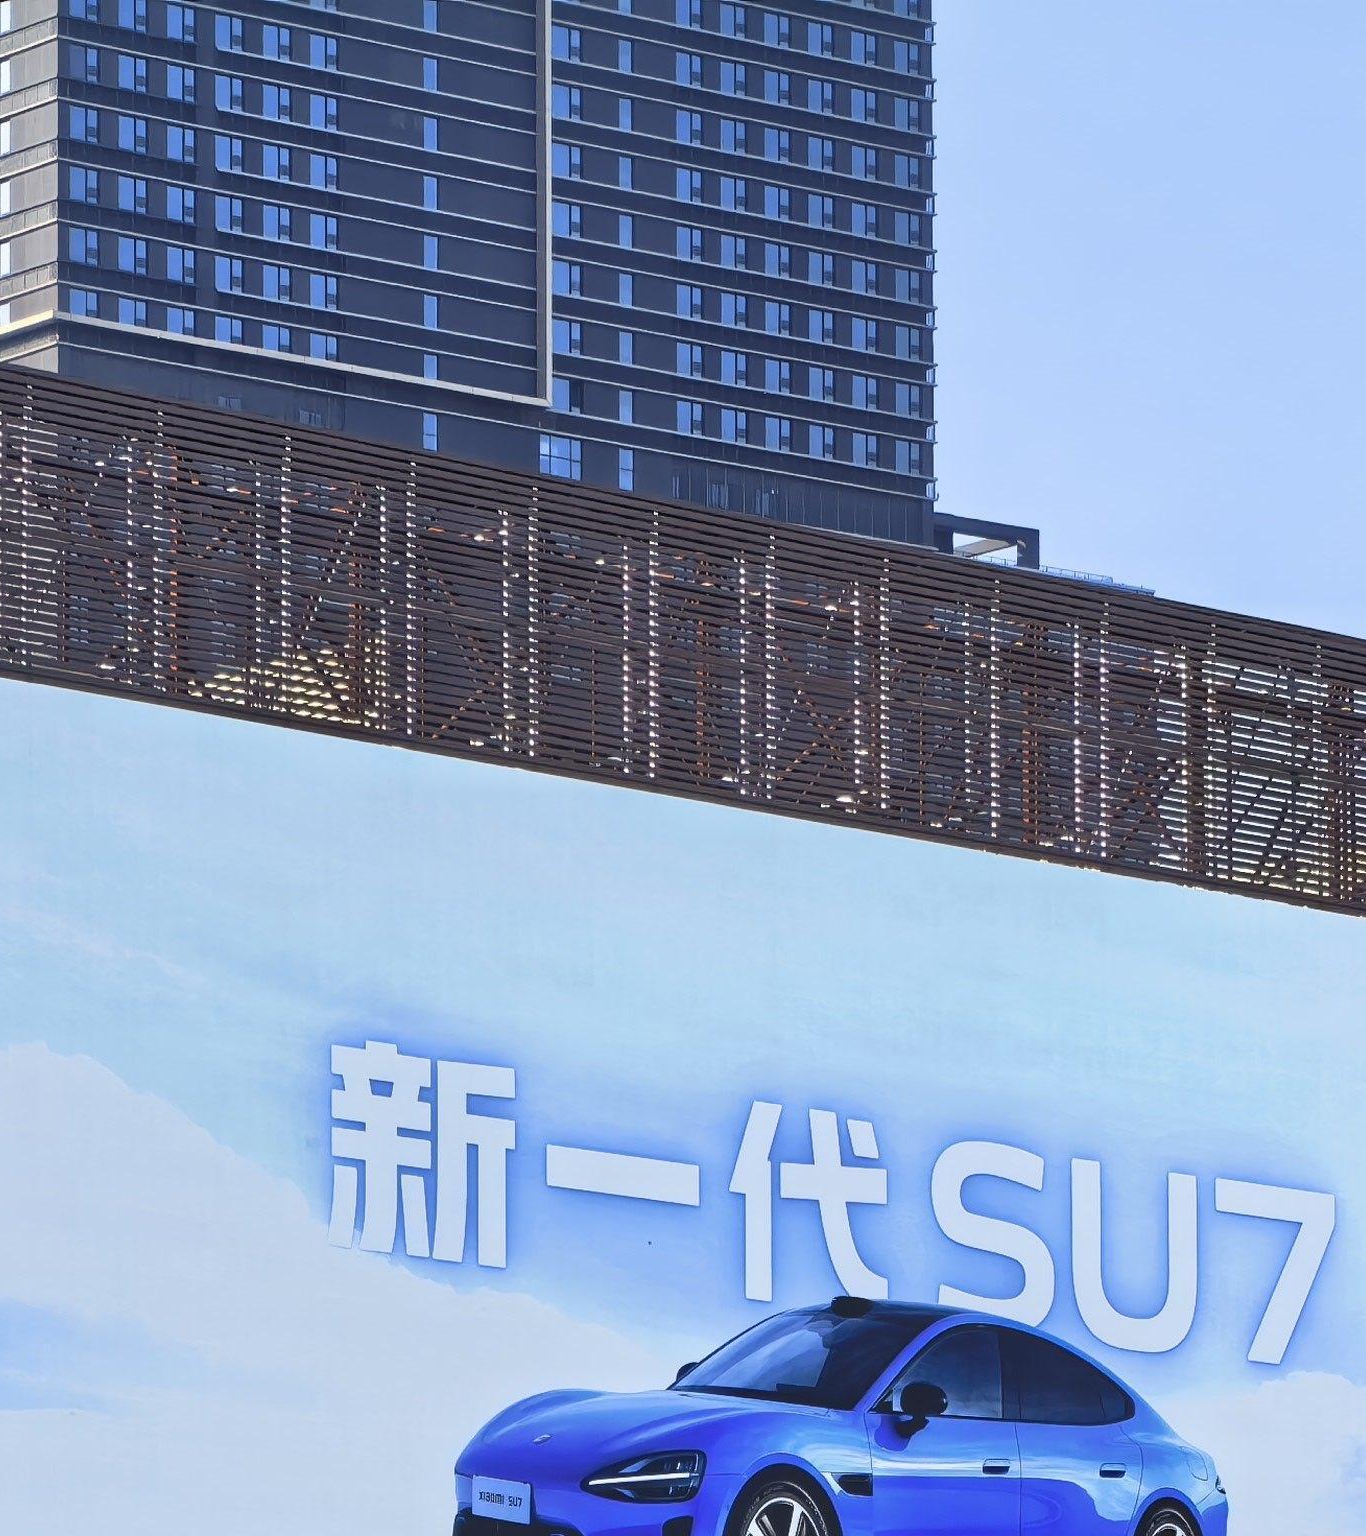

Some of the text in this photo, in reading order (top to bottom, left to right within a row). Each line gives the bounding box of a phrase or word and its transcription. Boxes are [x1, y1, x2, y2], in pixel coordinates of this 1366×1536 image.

[328, 1040, 1337, 1365] 新一代 SU7
